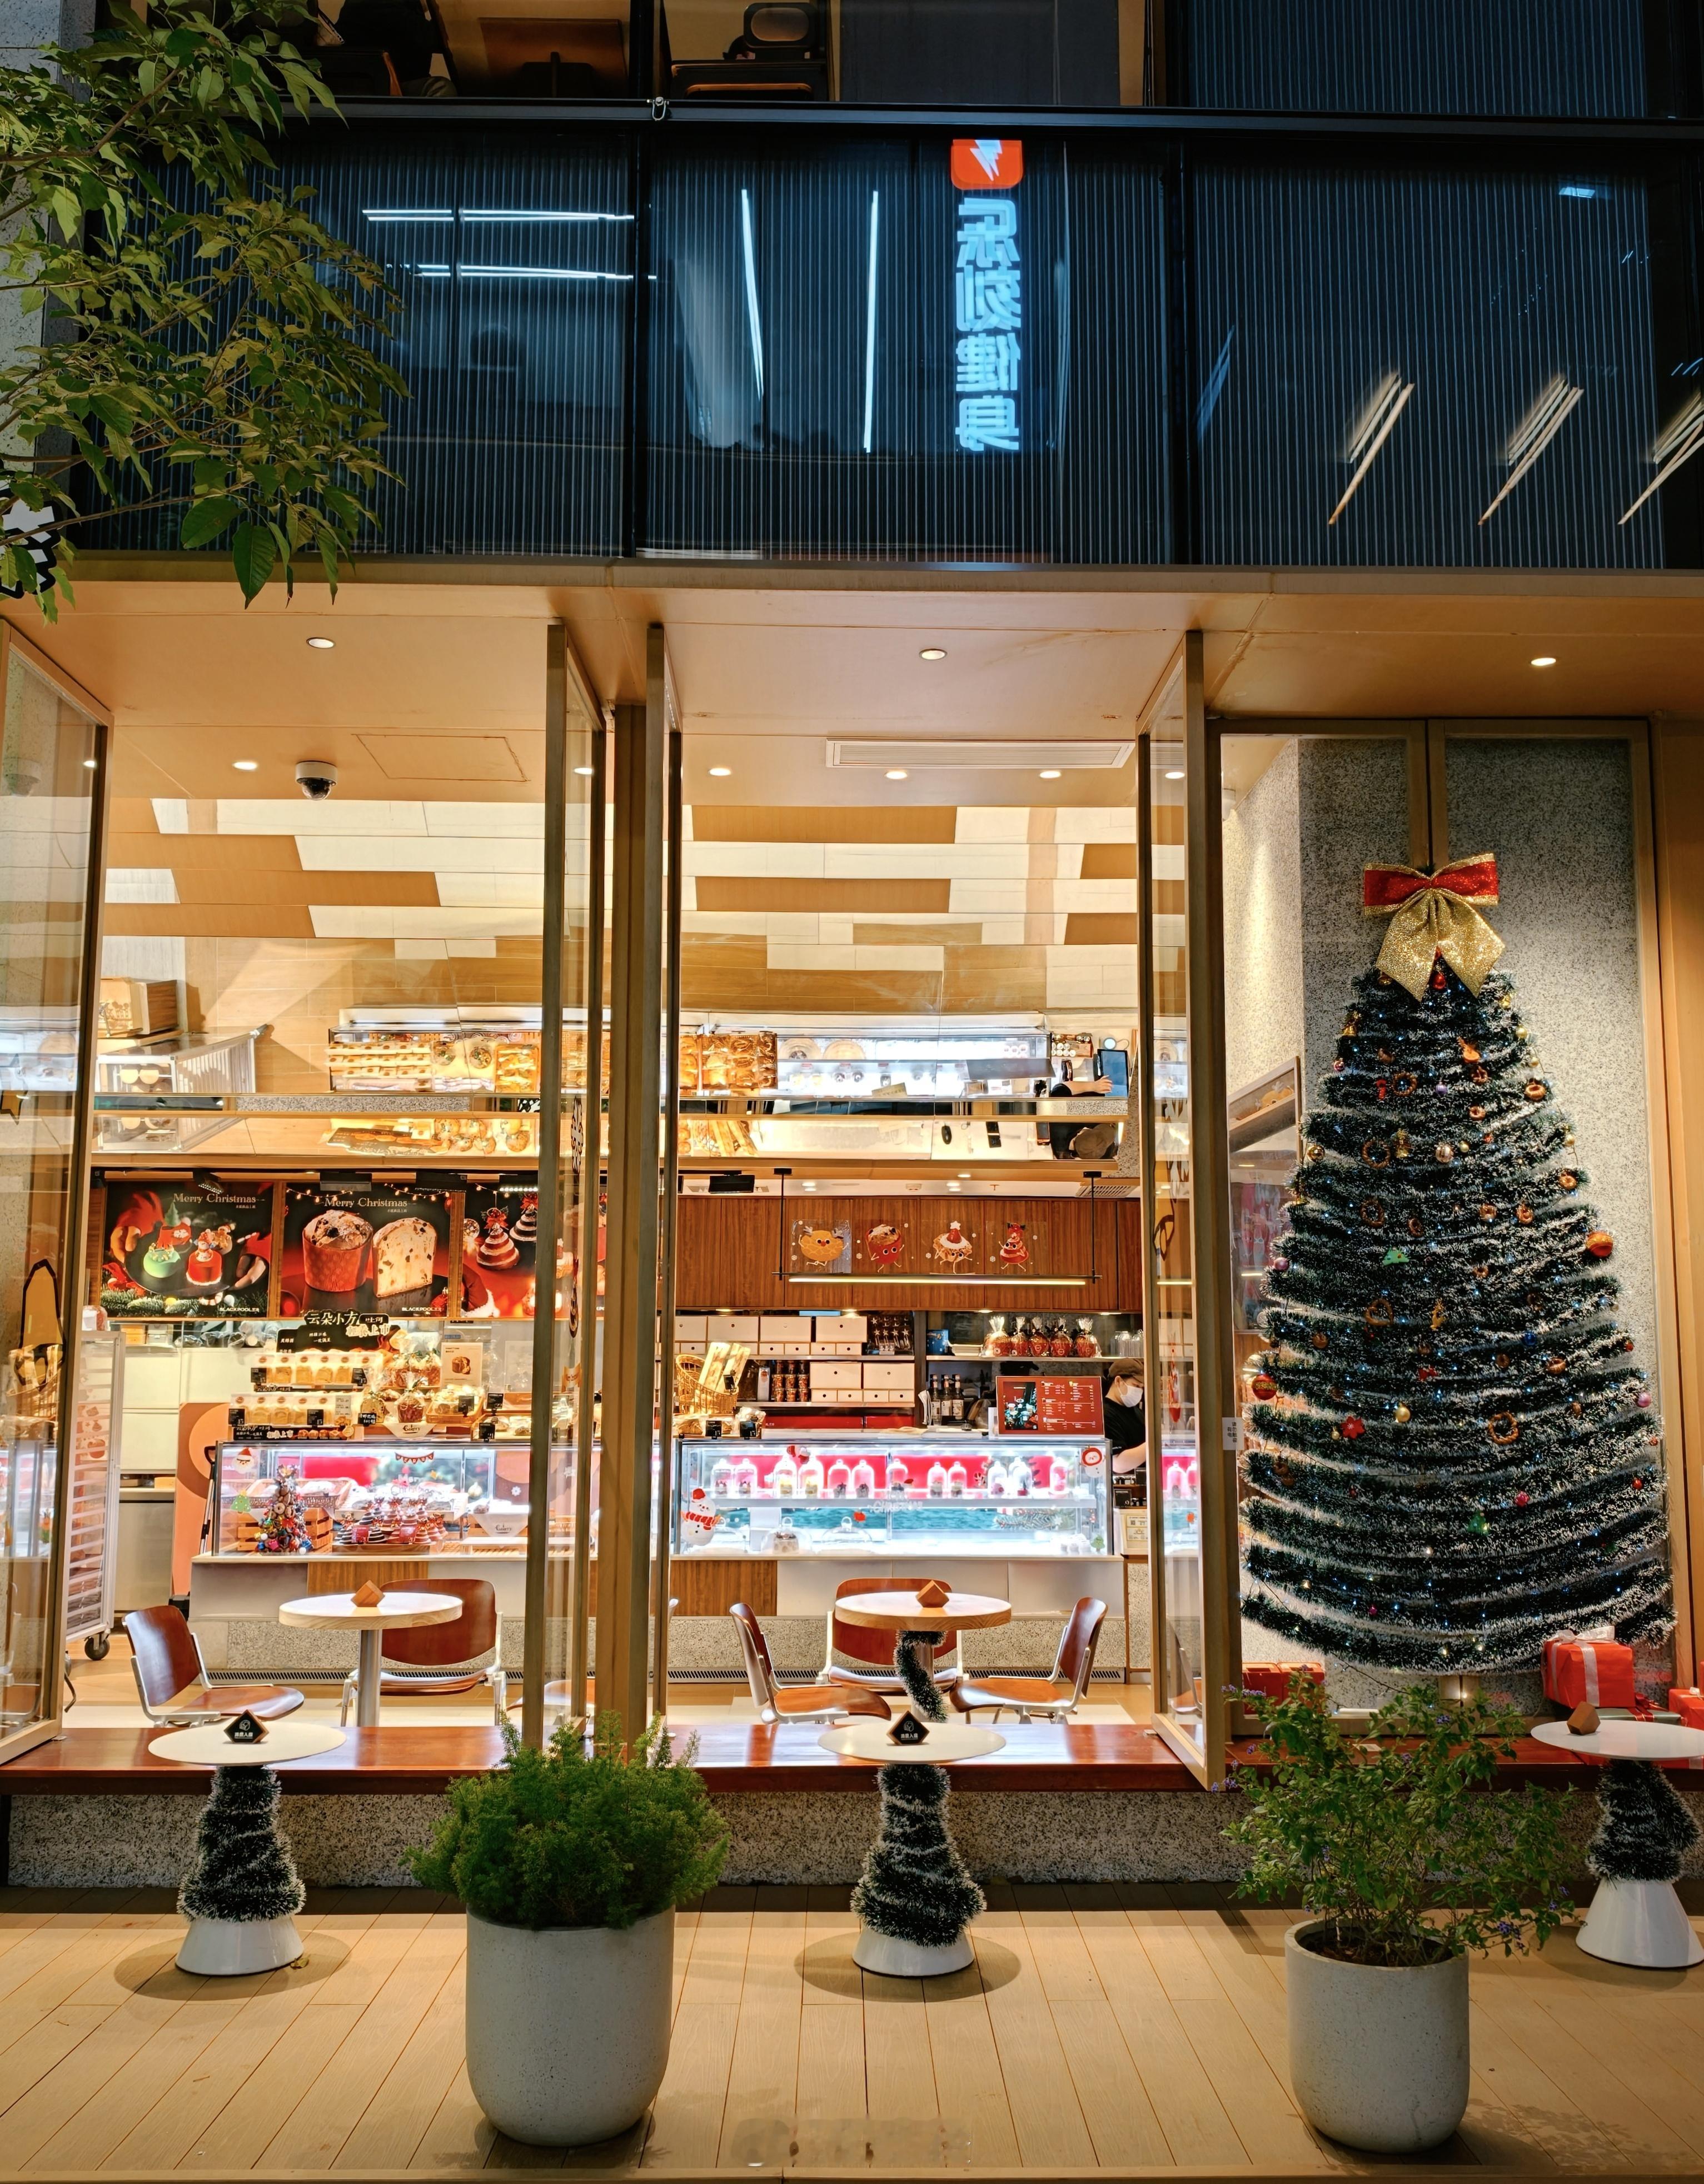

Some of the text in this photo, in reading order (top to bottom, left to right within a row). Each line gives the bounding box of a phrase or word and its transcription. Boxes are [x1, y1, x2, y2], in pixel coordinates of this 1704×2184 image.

[173, 1193, 256, 1203] Merry Christmas
[325, 1198, 407, 1208] Merry Christmas
[307, 1311, 360, 1325] 云朵小方
